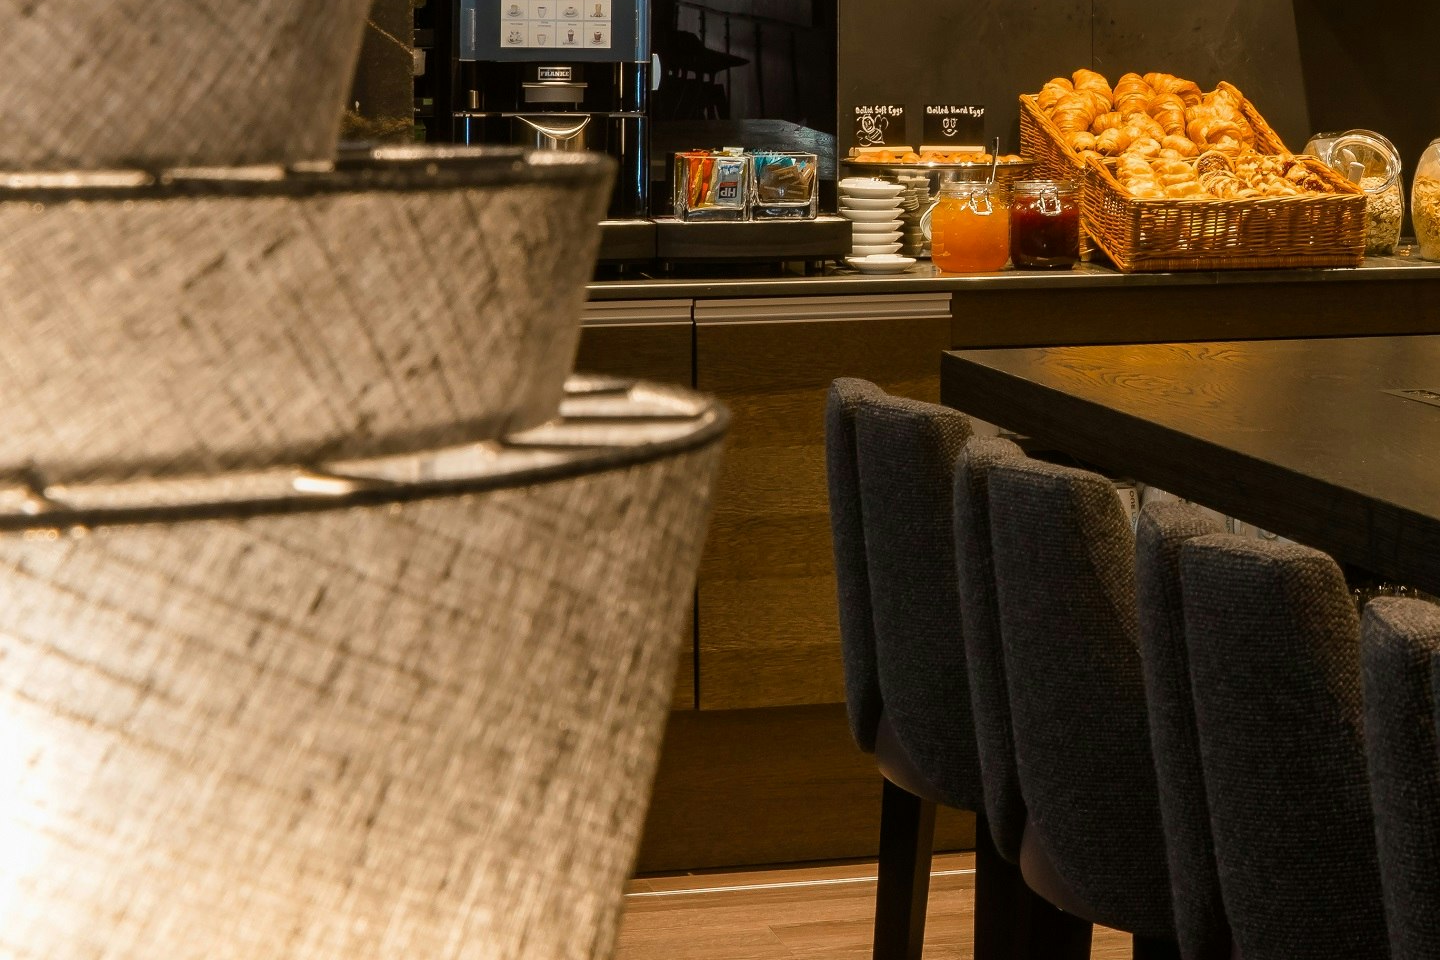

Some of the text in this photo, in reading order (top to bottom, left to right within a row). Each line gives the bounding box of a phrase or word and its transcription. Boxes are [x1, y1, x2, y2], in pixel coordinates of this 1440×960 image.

[875, 105, 886, 115] Soft
[888, 105, 903, 116] Eggs
[926, 106, 984, 117] Boiled Hard Eggs
[720, 187, 736, 197] HP
